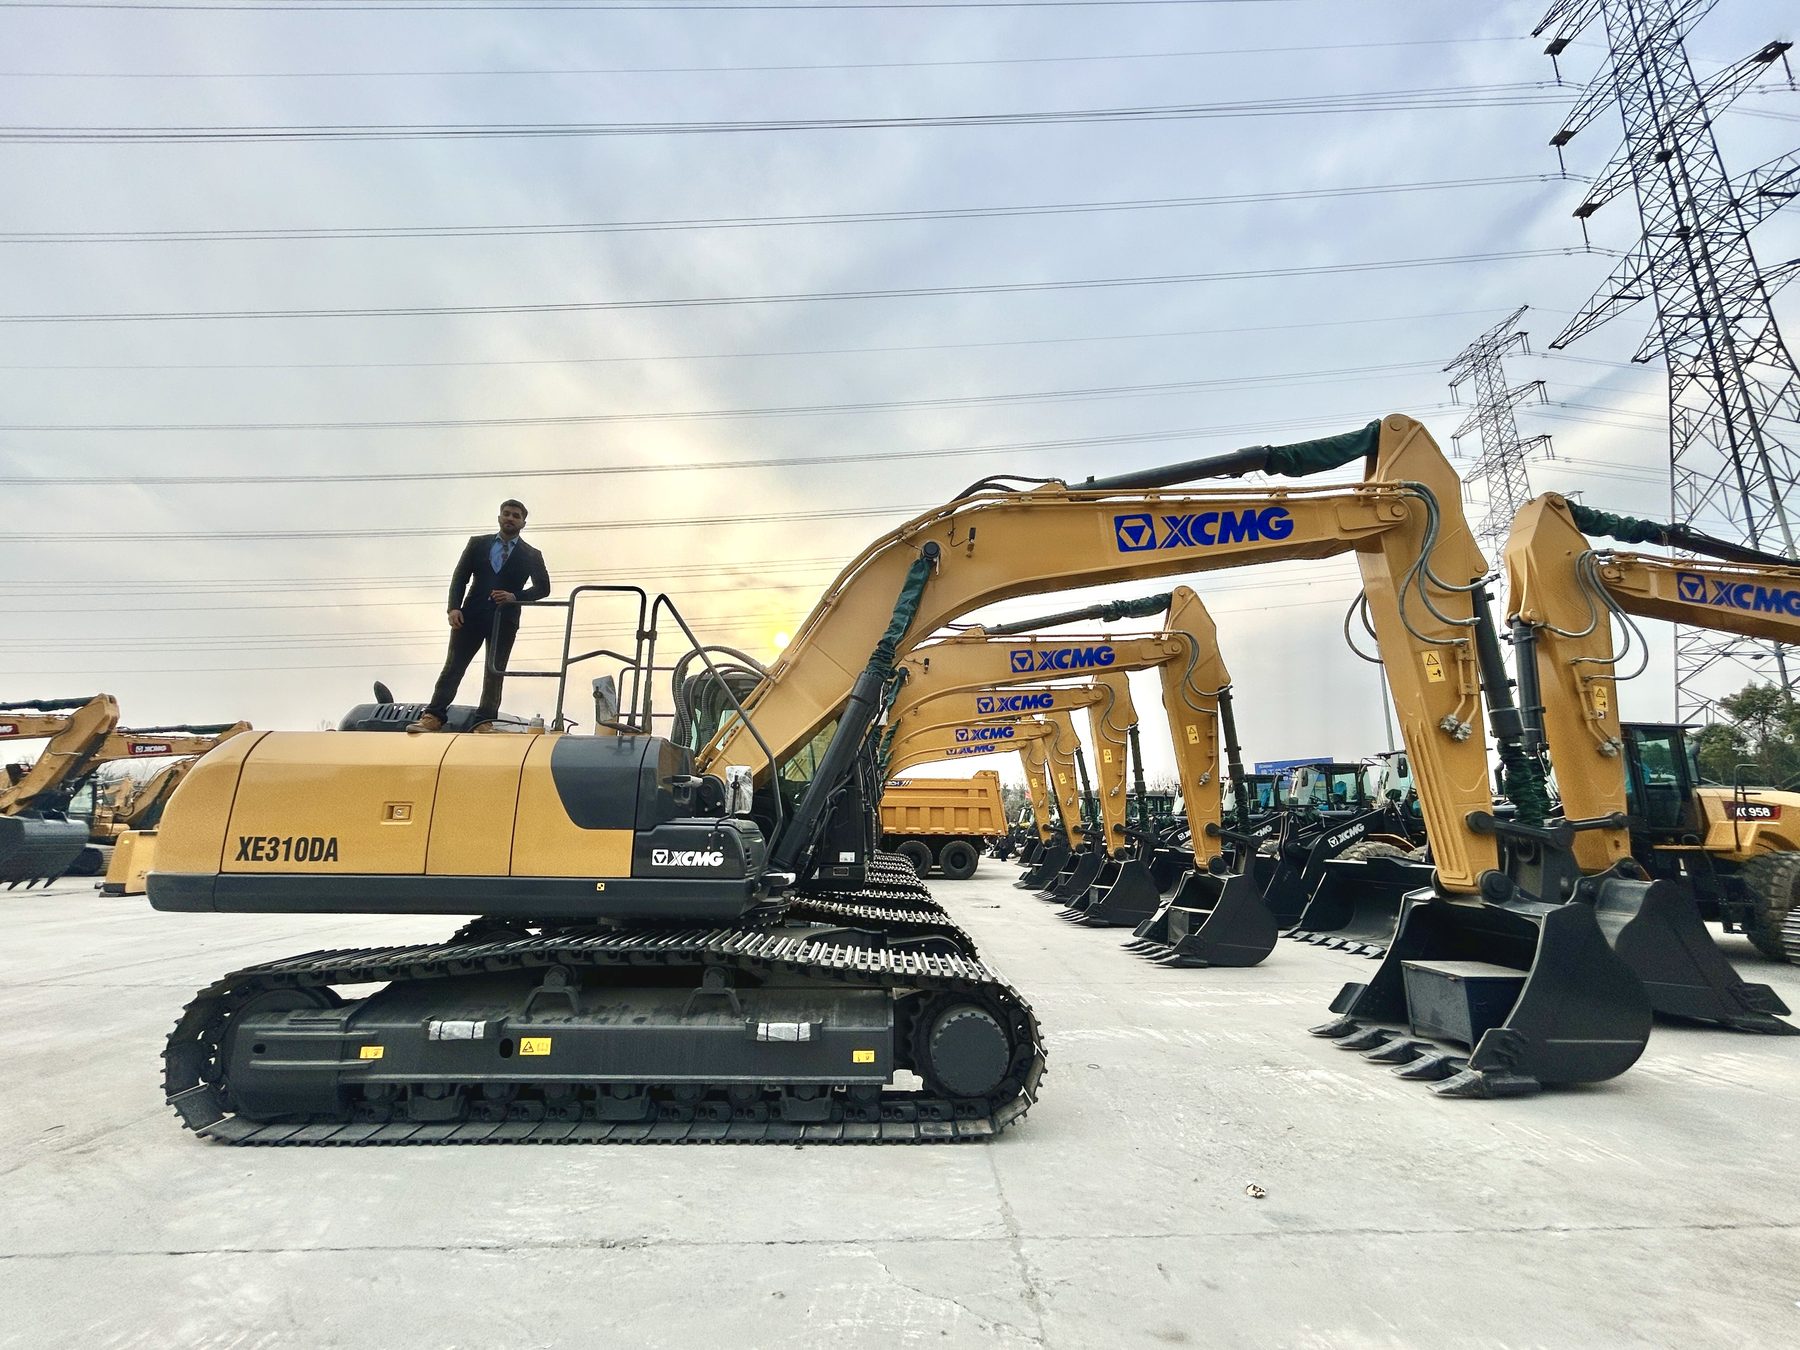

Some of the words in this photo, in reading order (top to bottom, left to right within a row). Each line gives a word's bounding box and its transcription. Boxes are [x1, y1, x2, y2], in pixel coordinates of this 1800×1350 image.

[1158, 506, 1294, 549] XCMG
[1708, 579, 1800, 617] XCMG
[1035, 645, 1116, 671] XCMG
[996, 693, 1054, 713] XCMG
[969, 726, 1015, 741] XCMG
[1337, 823, 1365, 844] XCMG
[235, 836, 339, 862] XE310DA
[667, 851, 725, 867] XCMG
